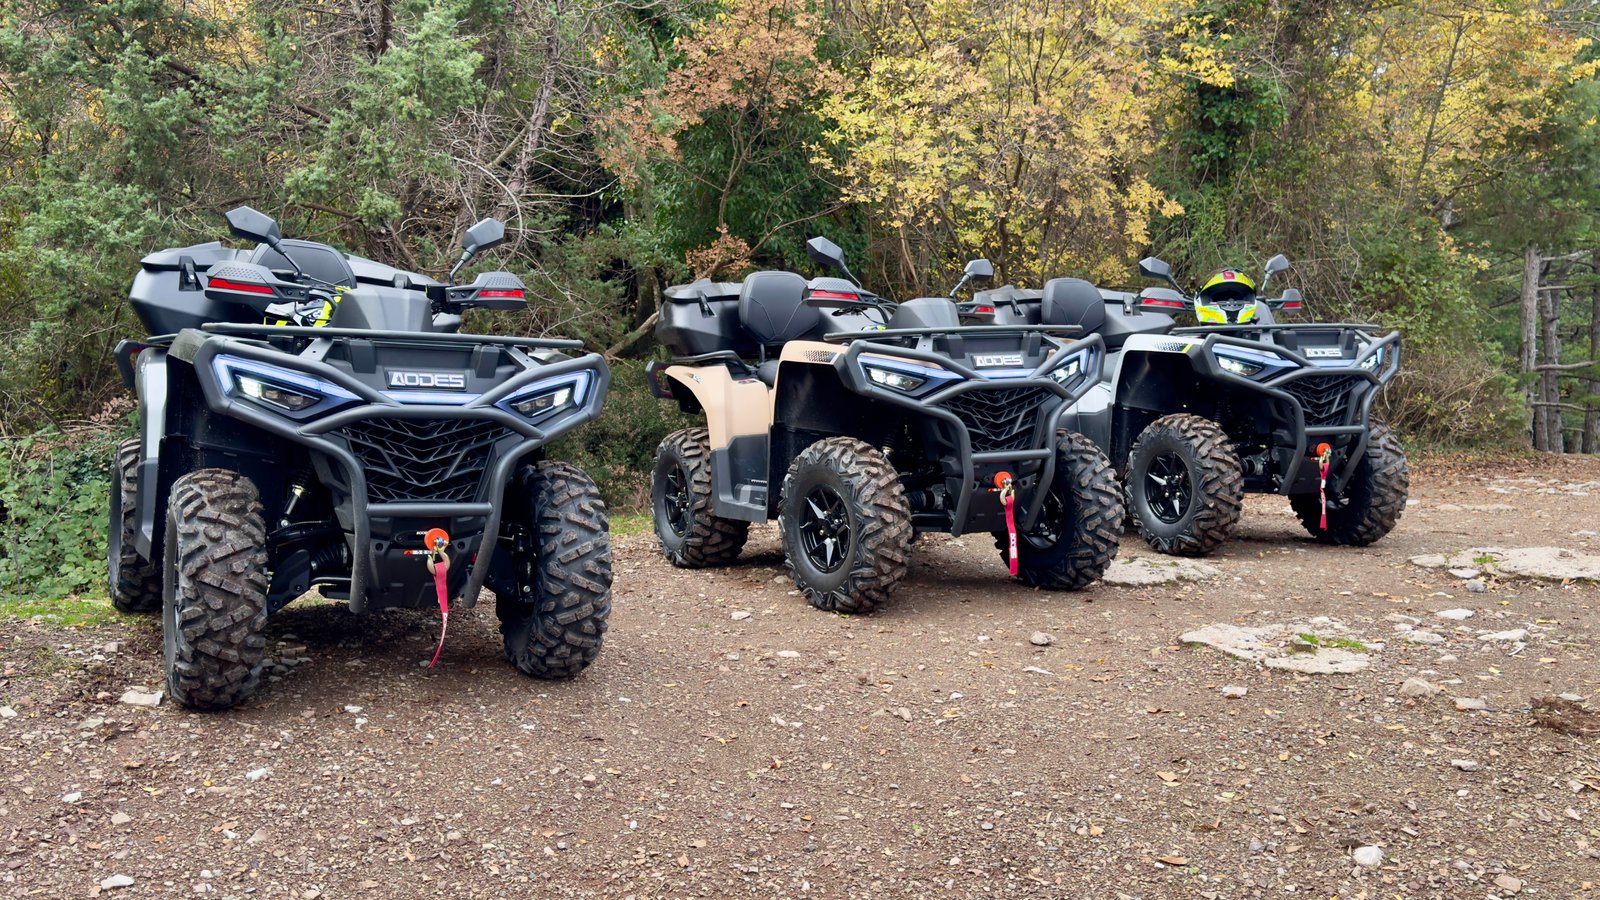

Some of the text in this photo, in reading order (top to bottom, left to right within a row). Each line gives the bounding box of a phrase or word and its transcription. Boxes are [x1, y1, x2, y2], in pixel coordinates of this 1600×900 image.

[1306, 348, 1342, 357] AODES
[976, 355, 1024, 366] AODES
[391, 372, 465, 388] AODES
